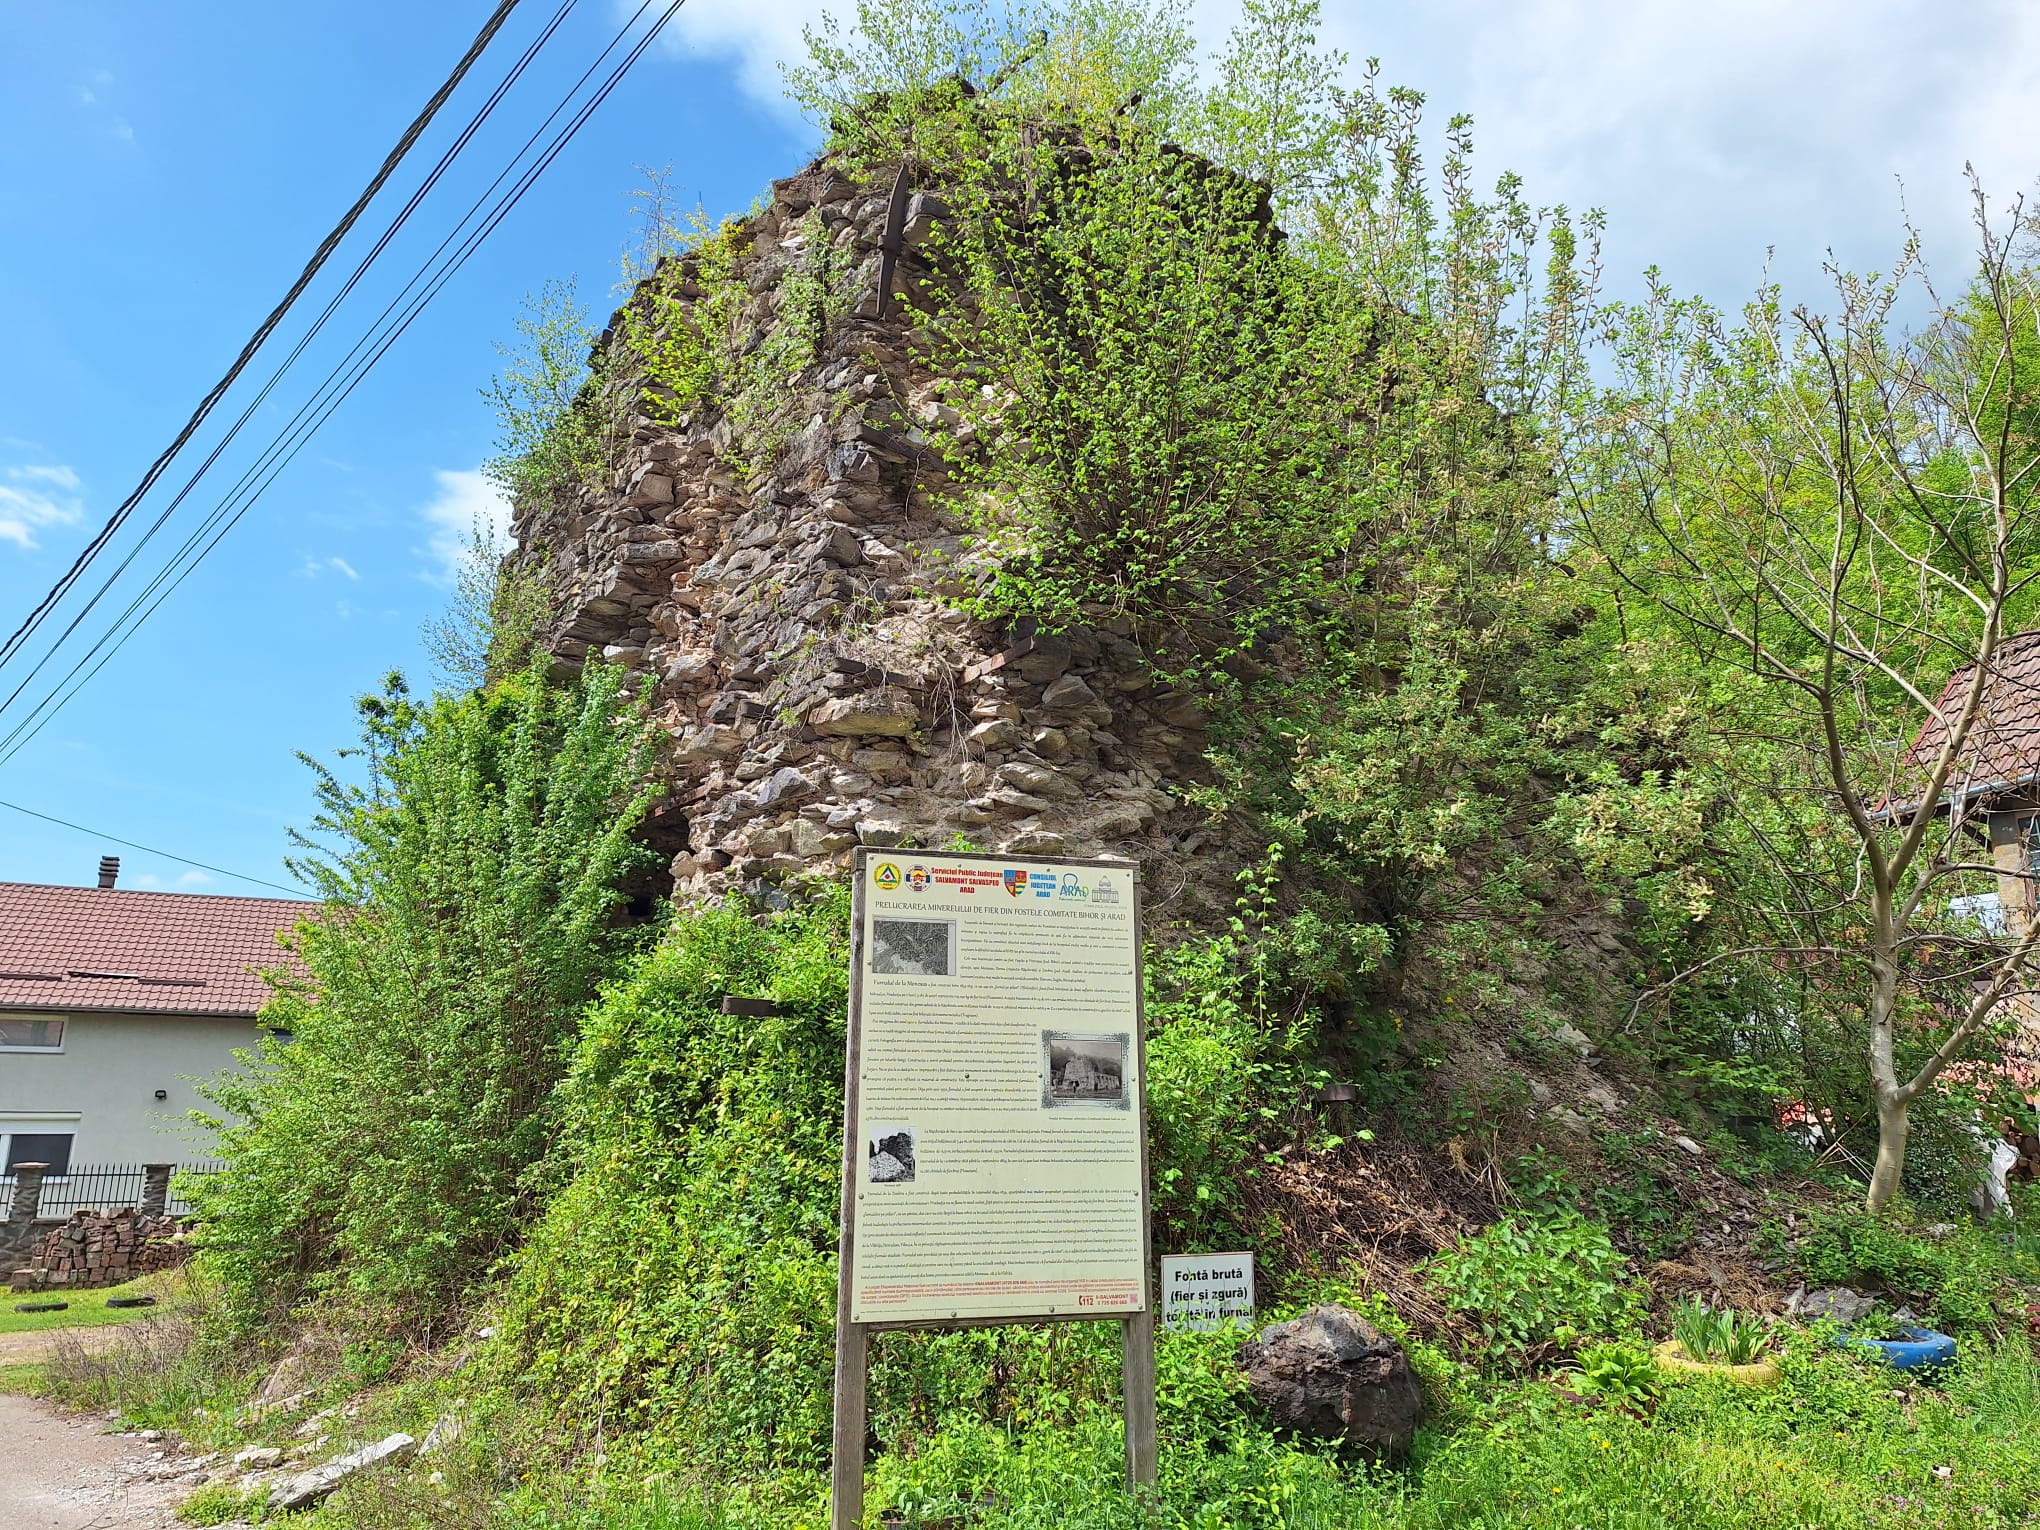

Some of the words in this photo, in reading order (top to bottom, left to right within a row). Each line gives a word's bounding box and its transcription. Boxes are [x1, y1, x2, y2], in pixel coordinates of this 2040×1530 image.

[931, 867, 958, 876] Serviciul
[958, 868, 976, 877] Public
[1029, 873, 1057, 881] CONSILIUL
[935, 876, 967, 885] SALVAMONT
[968, 878, 1000, 886] SALVASPEO
[1036, 890, 1051, 898] ARAD
[1060, 885, 1089, 898] ARAD
[875, 901, 926, 911] PRELUCRAREA
[928, 904, 972, 913] MINEREULUI
[973, 906, 984, 914] DE
[984, 906, 999, 914] FIER
[1000, 907, 1013, 915] DIN
[1014, 908, 1043, 917] FOSTELE
[1043, 909, 1078, 919] COMITATE
[1078, 911, 1099, 920] BIHOR
[1107, 913, 1126, 921] ARAD
[1212, 1267, 1243, 1280] brută
[1171, 1290, 1195, 1304] (fier
[1212, 1286, 1248, 1302] zgură)
[1083, 1297, 1094, 1306] 112
